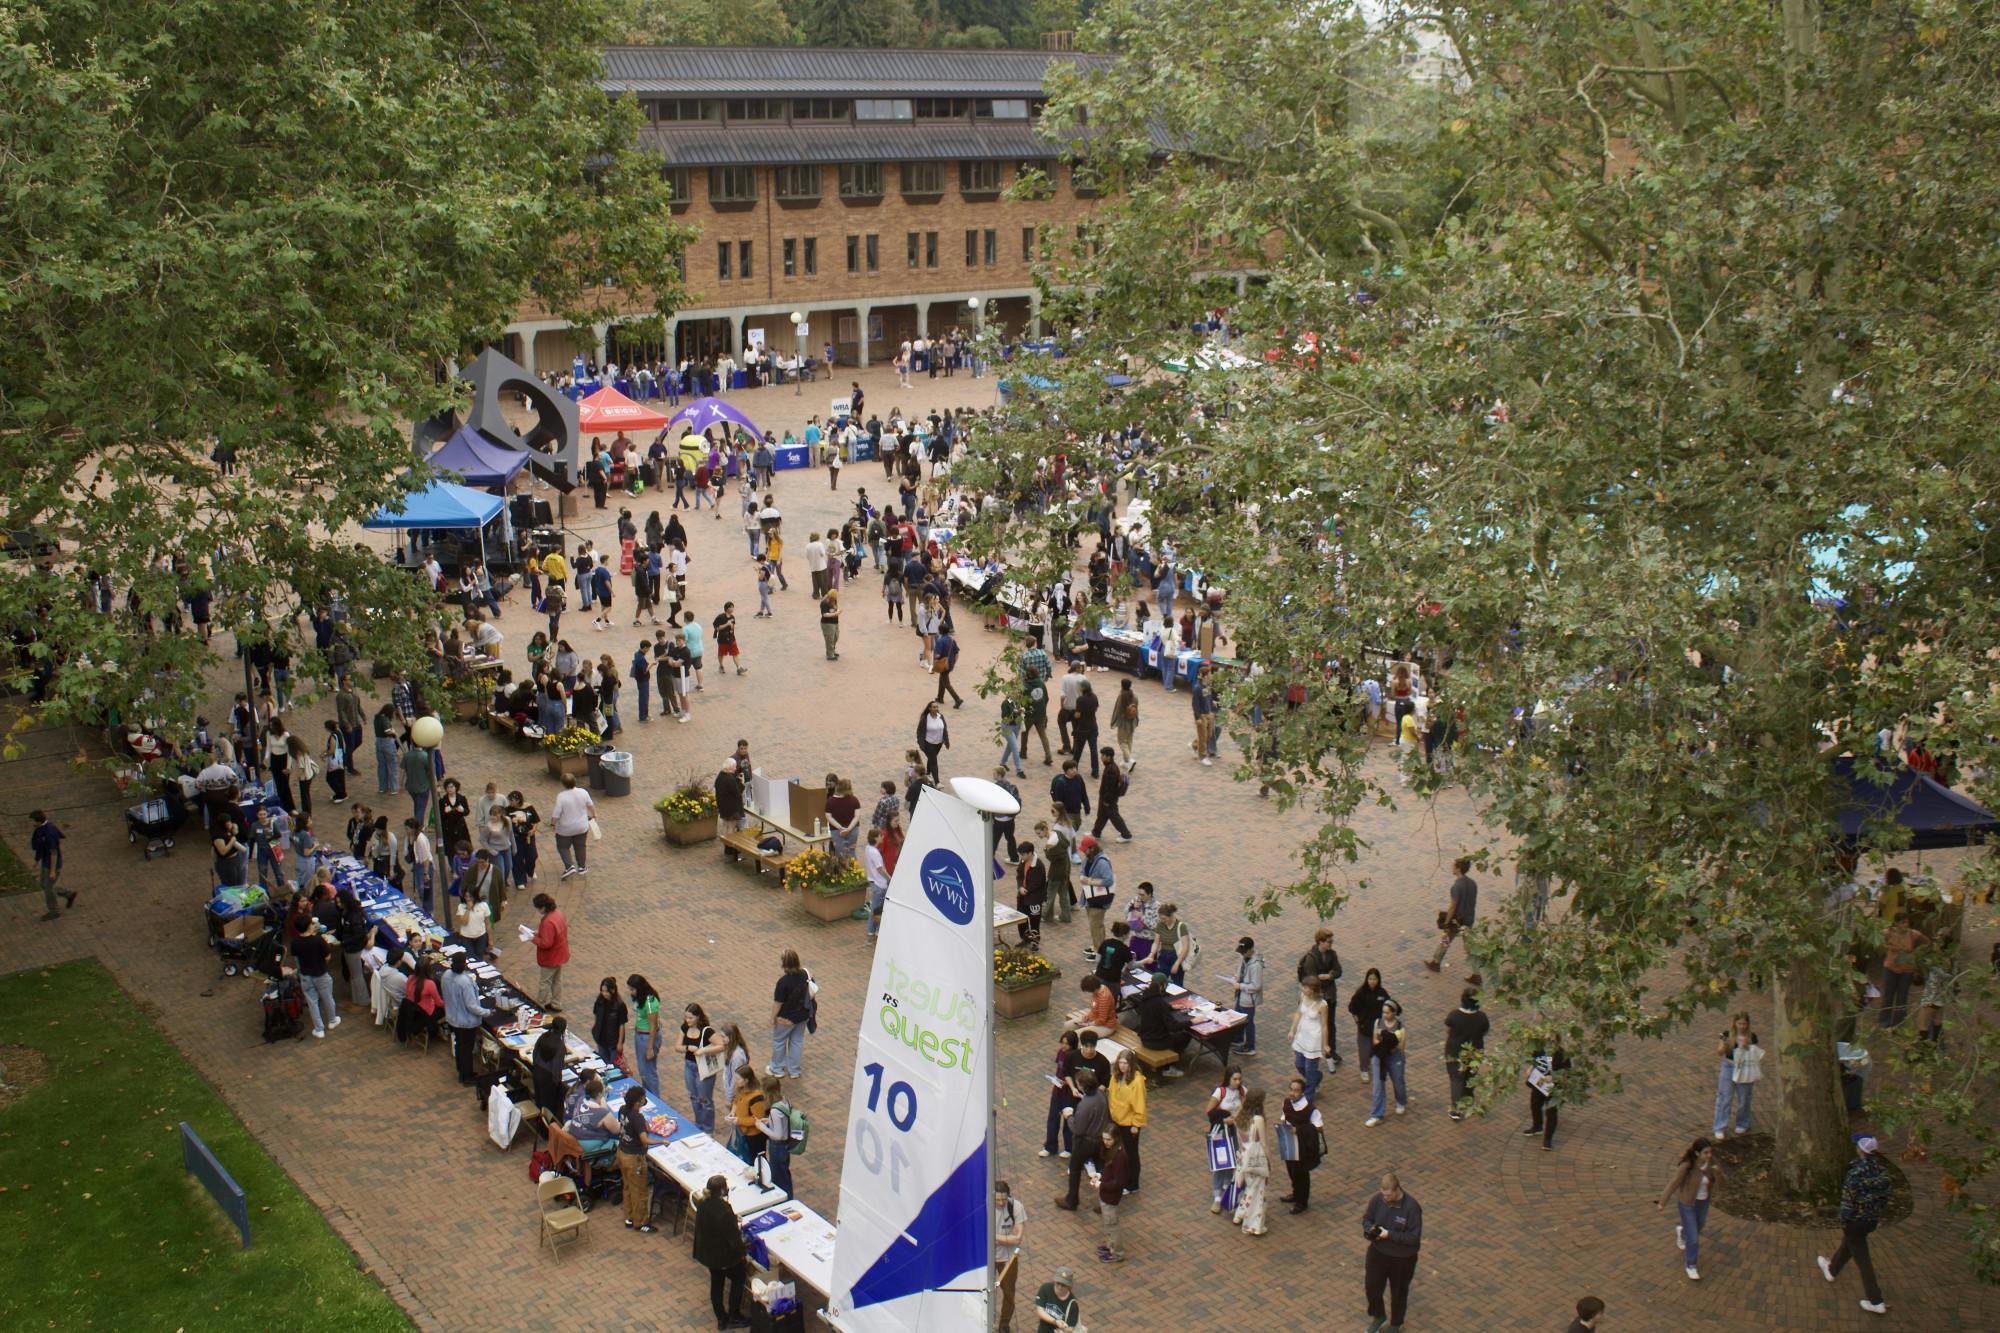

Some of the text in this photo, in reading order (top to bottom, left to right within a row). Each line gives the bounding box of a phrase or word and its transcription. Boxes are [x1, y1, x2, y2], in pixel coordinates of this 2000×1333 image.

[928, 876, 968, 913] WWU
[882, 993, 898, 1007] RS
[880, 1006, 974, 1074] Quest
[864, 1062, 917, 1132] 10
